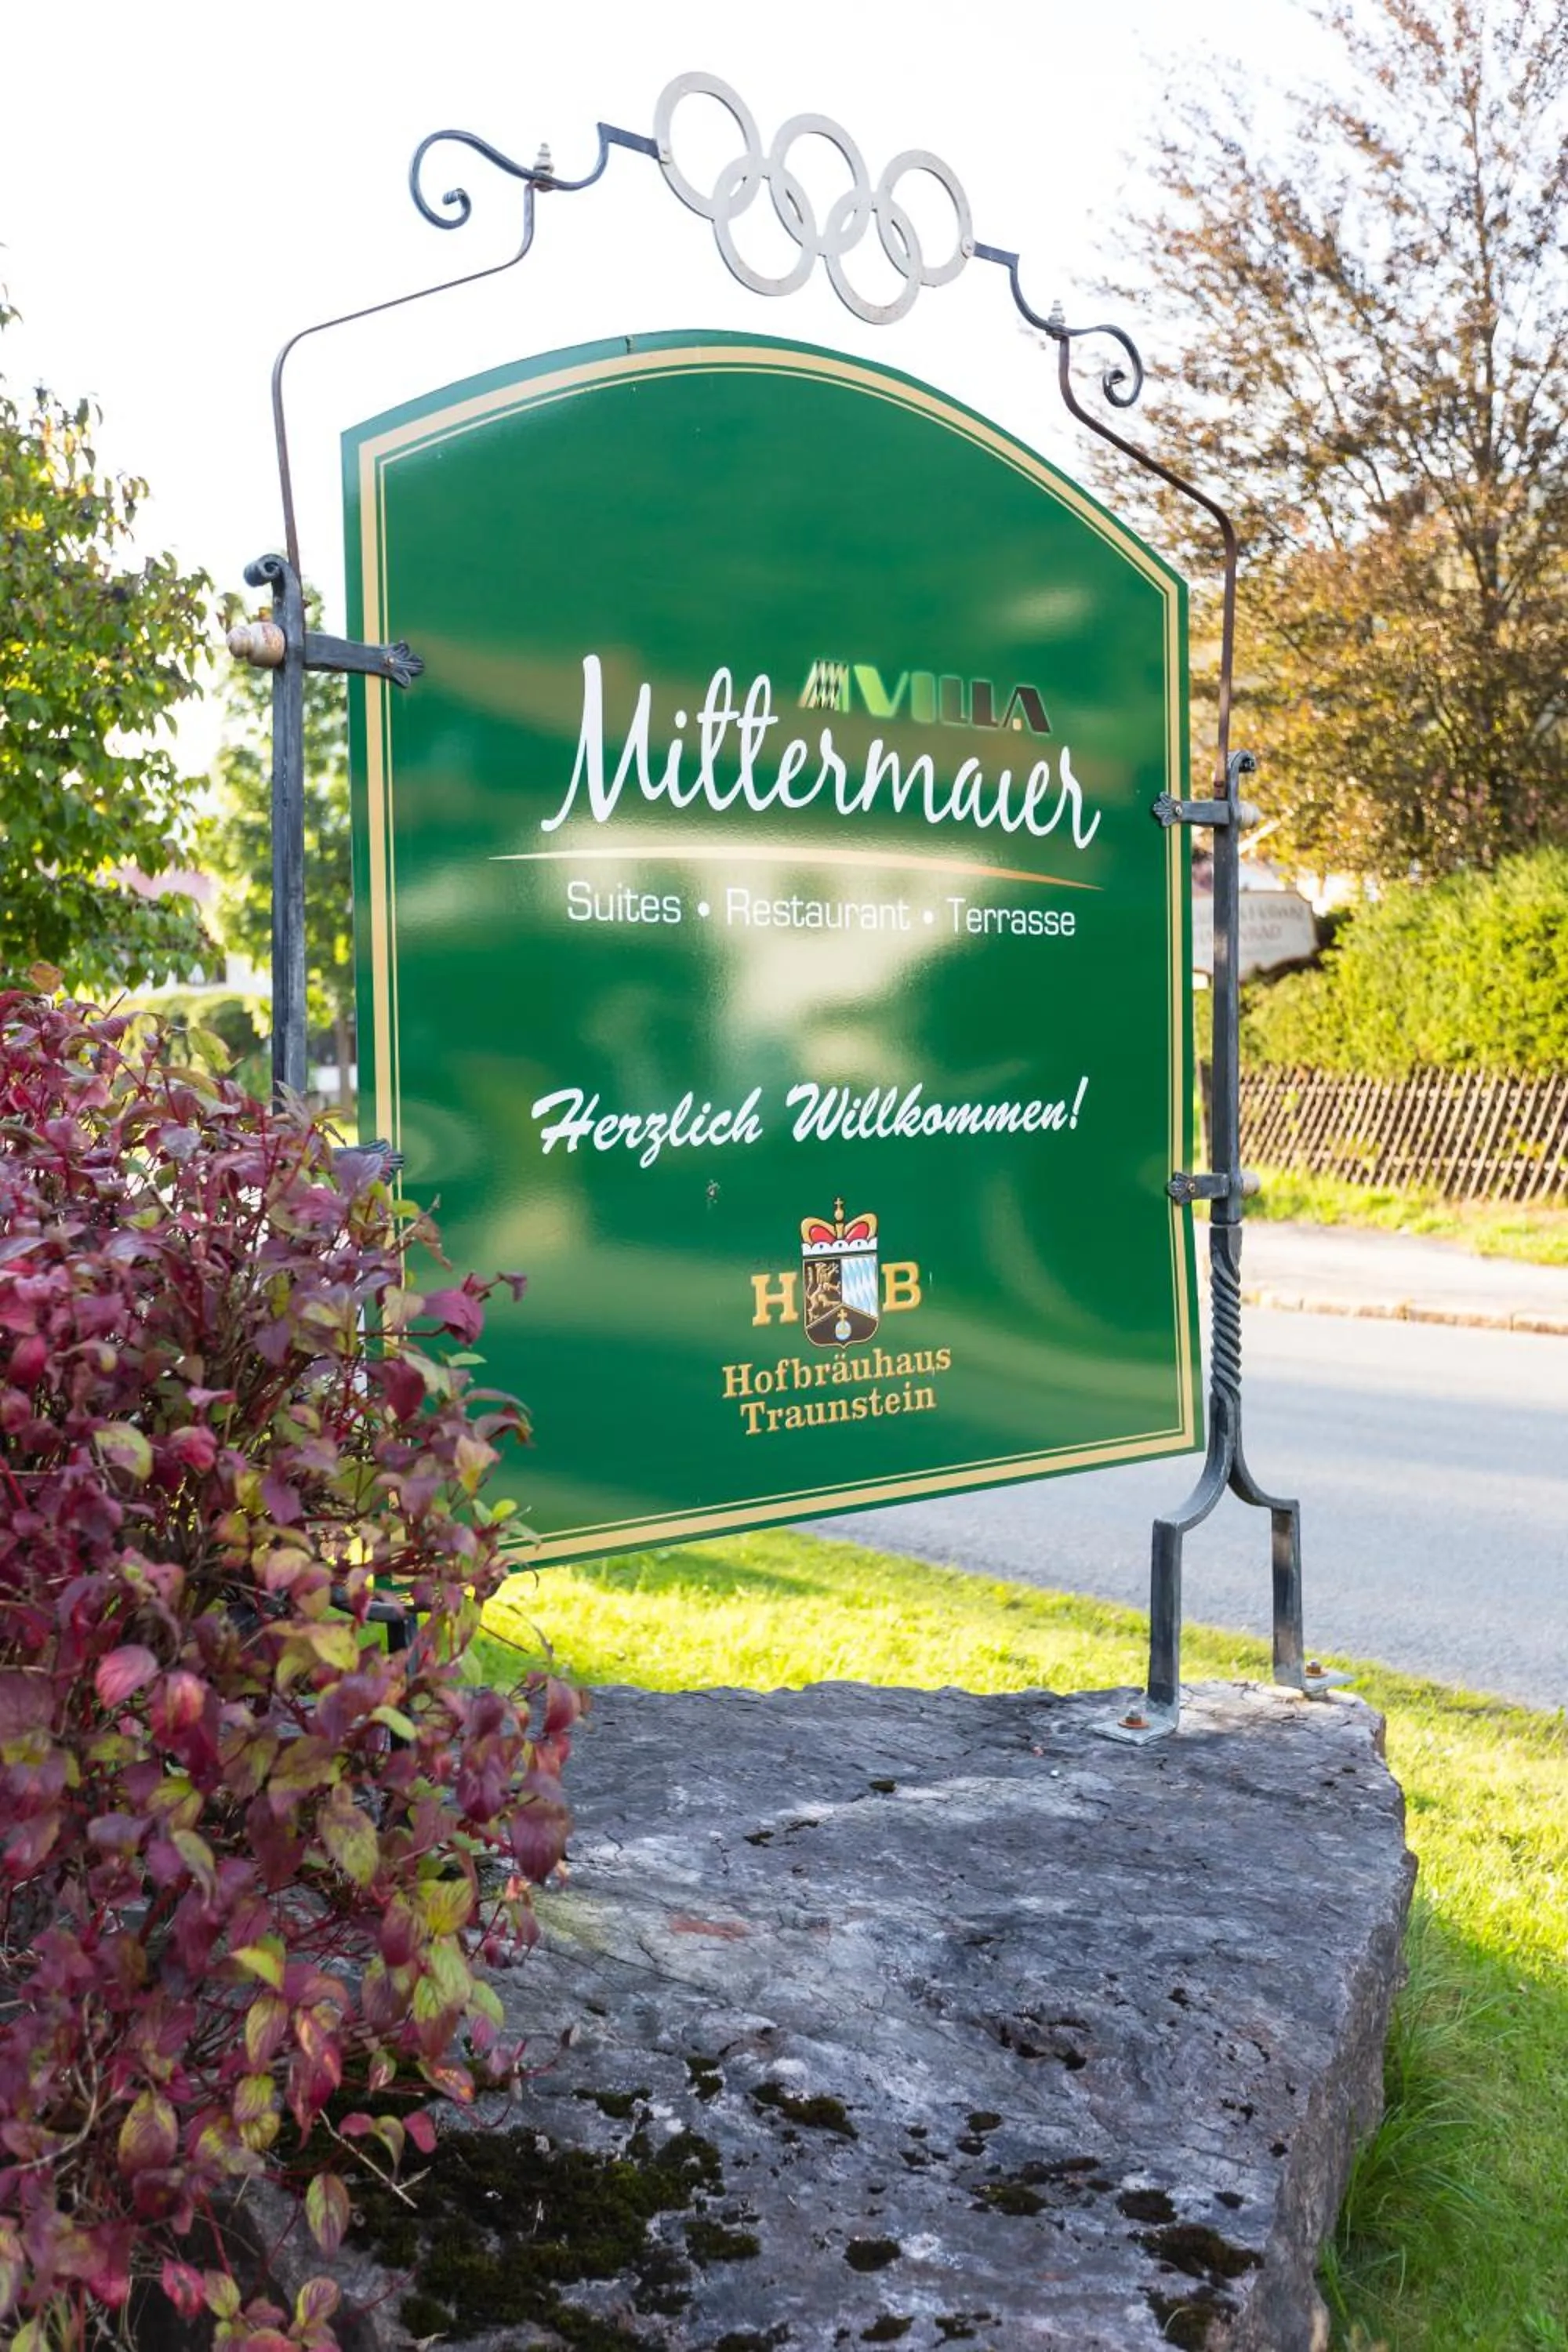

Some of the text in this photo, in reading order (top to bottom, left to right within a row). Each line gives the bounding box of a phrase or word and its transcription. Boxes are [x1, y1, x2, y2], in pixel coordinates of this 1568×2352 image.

[852, 664, 1052, 735] VILLA
[567, 881, 1076, 937] Suites Restaurant Terrasse
[531, 1076, 1089, 1168] Herzlich Willkommen!
[750, 1261, 922, 1326] H B
[722, 1347, 952, 1398] Hofbräuhaus
[740, 1381, 937, 1435] Traunstein
